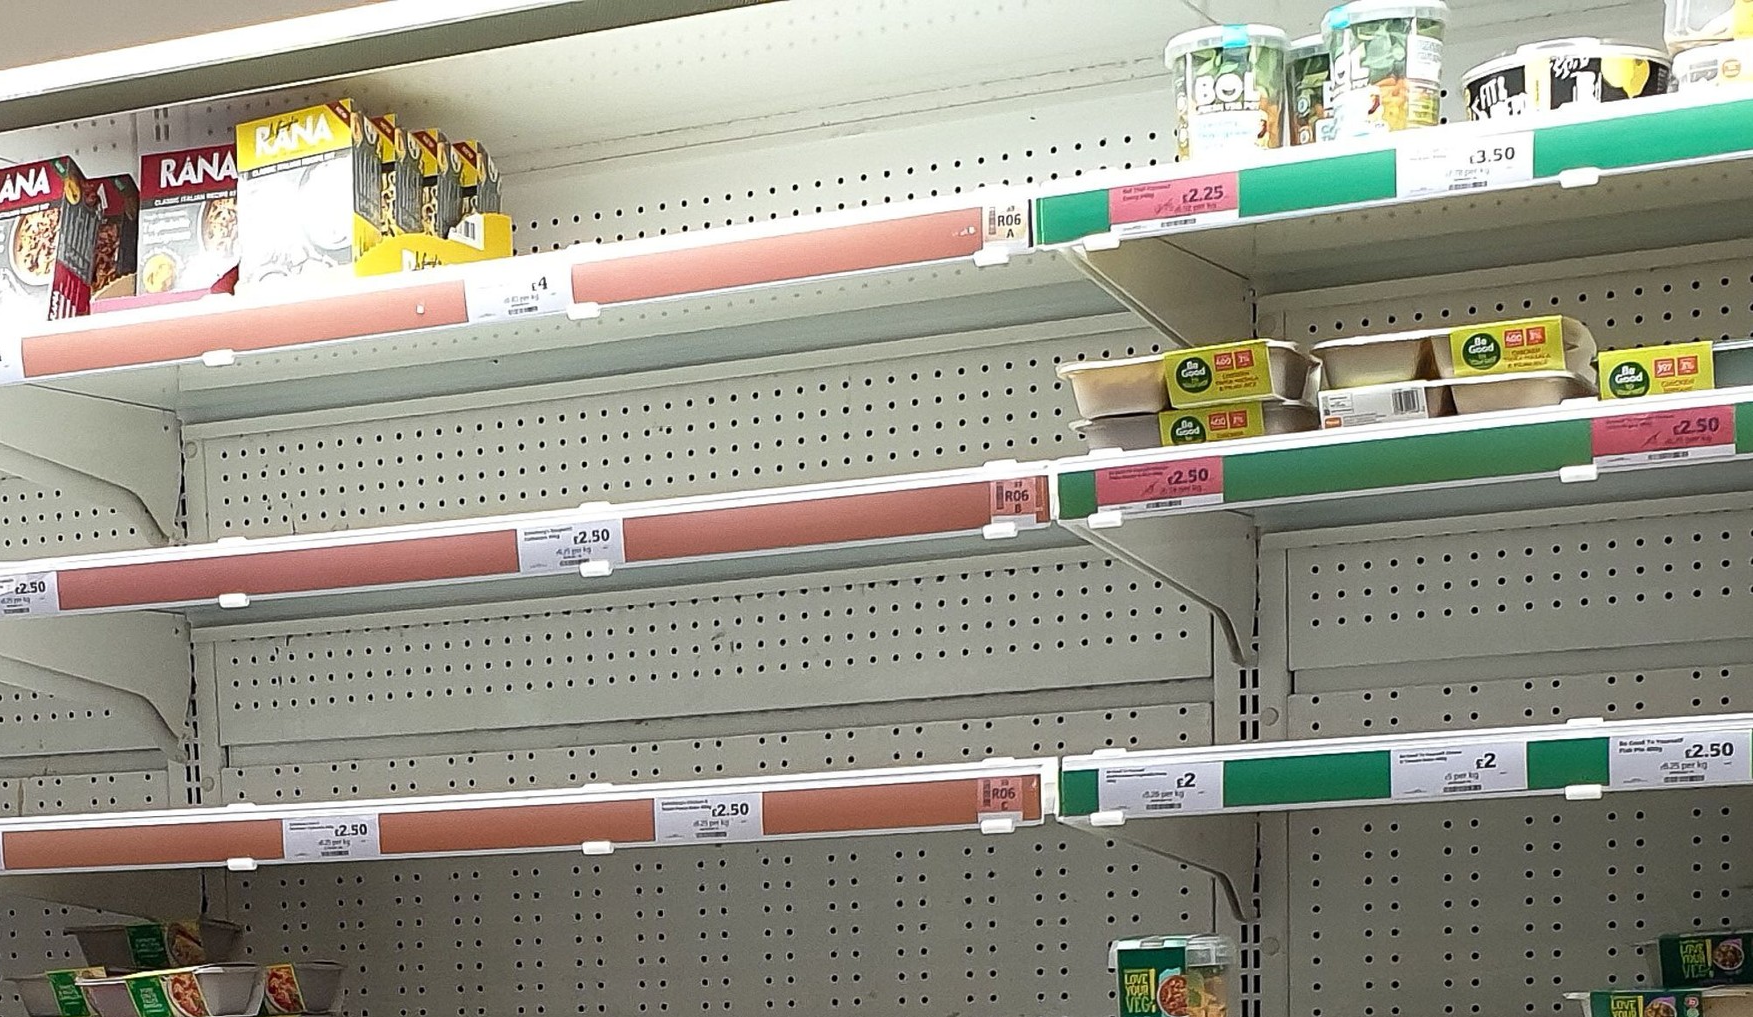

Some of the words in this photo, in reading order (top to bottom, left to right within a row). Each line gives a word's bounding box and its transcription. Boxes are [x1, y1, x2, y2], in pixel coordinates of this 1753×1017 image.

[1195, 71, 1260, 106] BOL
[255, 114, 336, 156] RANA
[1469, 147, 1515, 164] £3.50
[159, 151, 238, 188] RANA
[1182, 185, 1224, 205] £2.25
[998, 212, 1022, 227] R06
[1006, 228, 1015, 239] A
[532, 276, 548, 291] £4
[1468, 343, 1495, 354] Good
[1181, 366, 1206, 378] Good
[1615, 372, 1643, 384] Good
[1673, 417, 1720, 436] £2.50
[1167, 468, 1209, 486] £2.50
[1004, 489, 1030, 502] R06
[573, 529, 610, 545] £2.50
[15, 581, 46, 595] £2.50
[1685, 742, 1734, 758] £2.50
[1475, 753, 1496, 769] £2
[1176, 773, 1196, 789] £2
[992, 788, 1016, 799] R06
[712, 803, 749, 817] £2.50
[335, 824, 368, 837] £2.50
[1124, 973, 1149, 985] LOVE
[1125, 985, 1149, 996] YOUR
[1610, 997, 1637, 1010] LOVE
